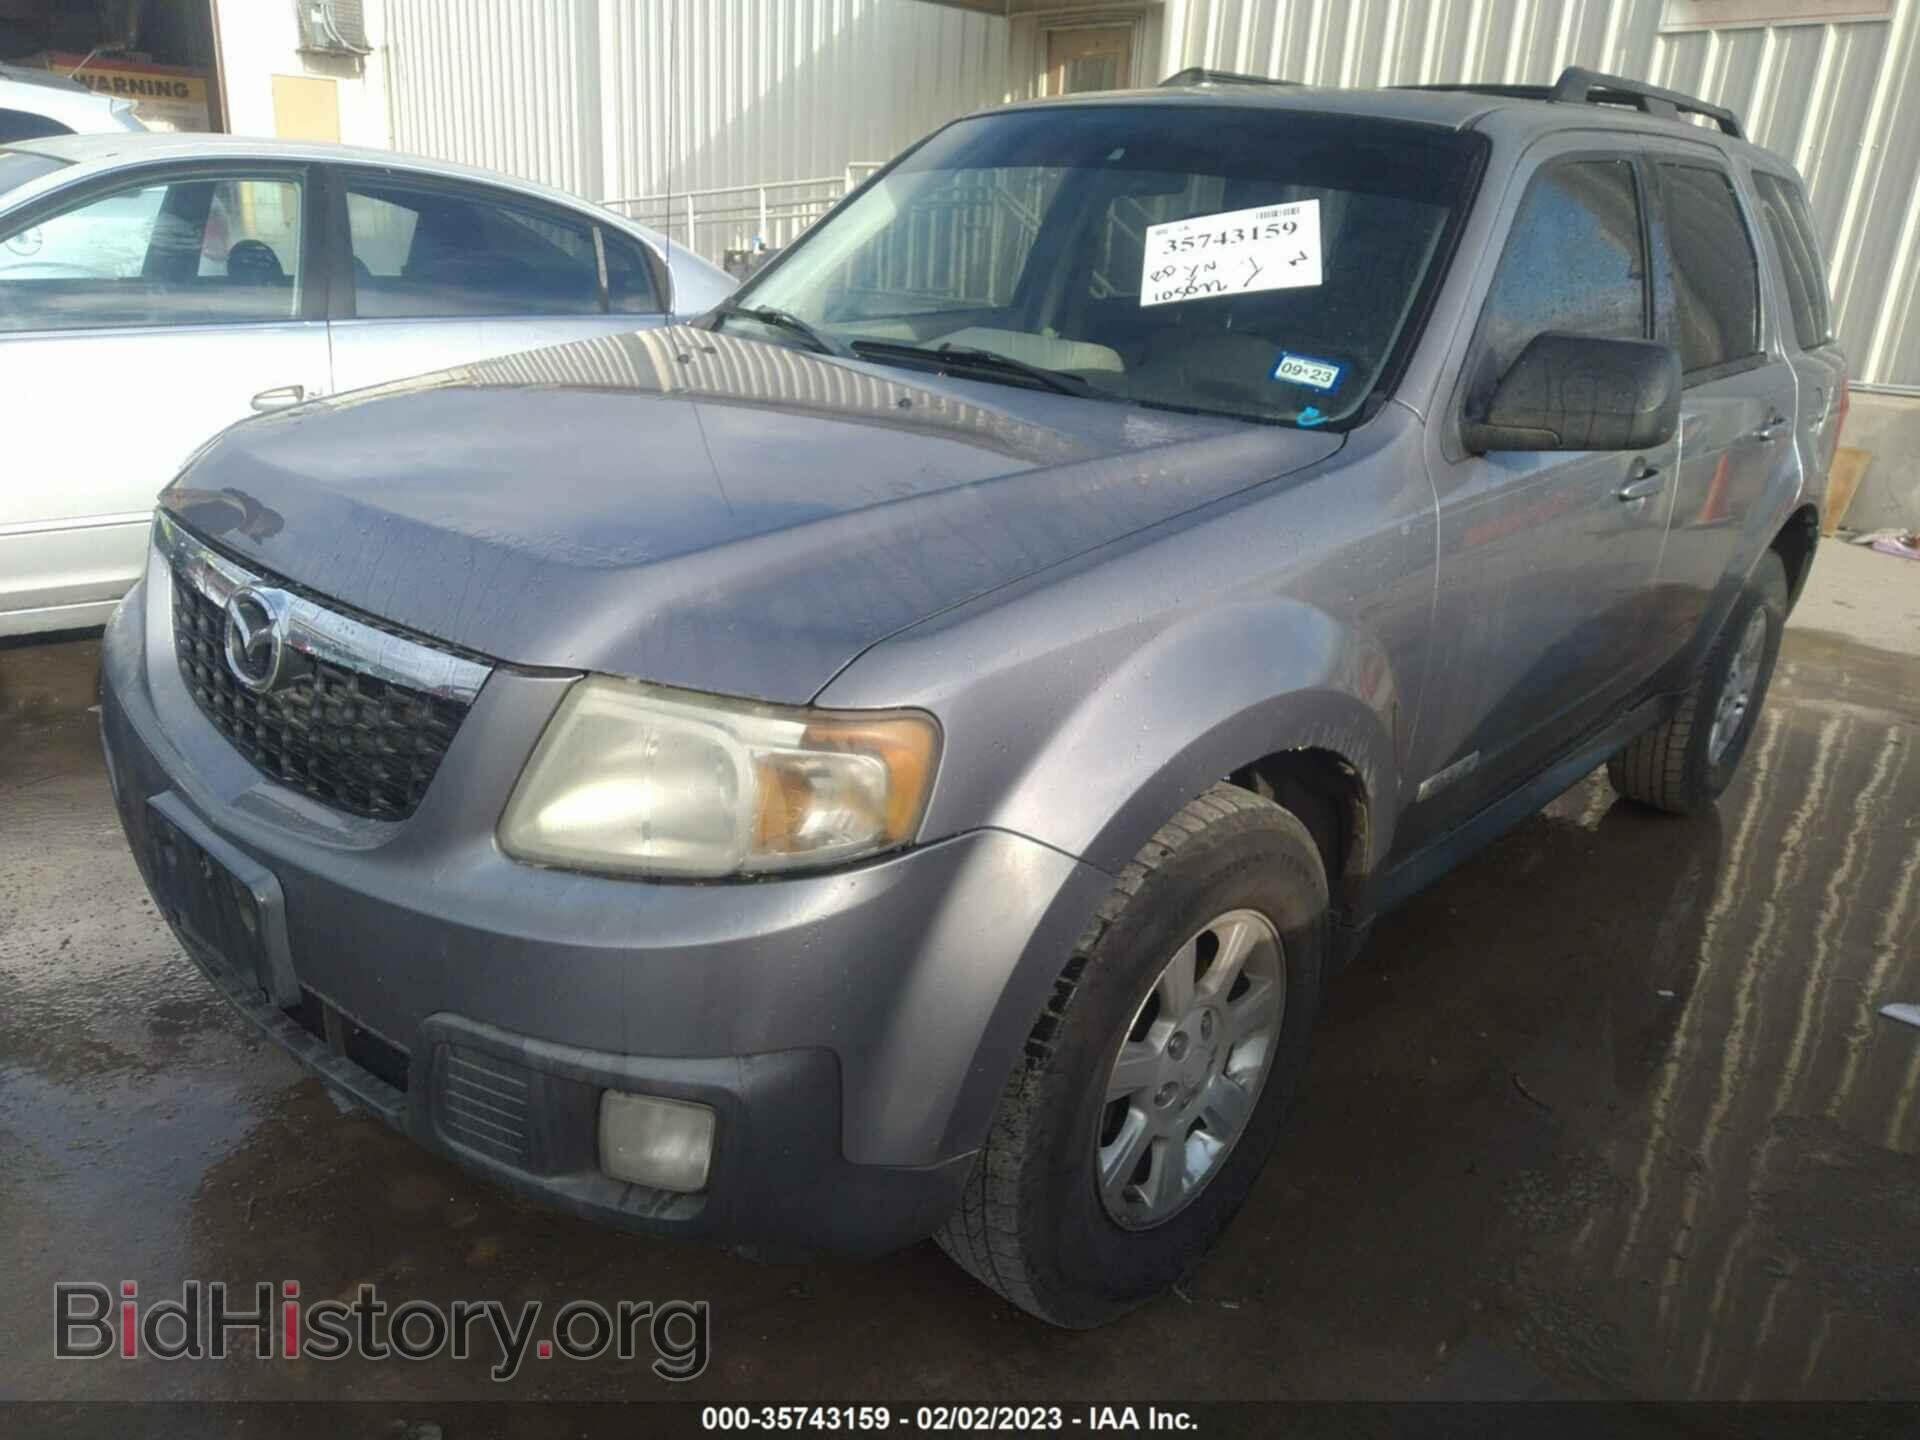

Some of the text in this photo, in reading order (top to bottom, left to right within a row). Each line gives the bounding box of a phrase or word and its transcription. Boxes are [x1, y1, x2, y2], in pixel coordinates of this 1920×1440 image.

[72, 74, 189, 98] WARNING
[1162, 221, 1298, 255] 35743159
[1281, 362, 1332, 383] 09 23
